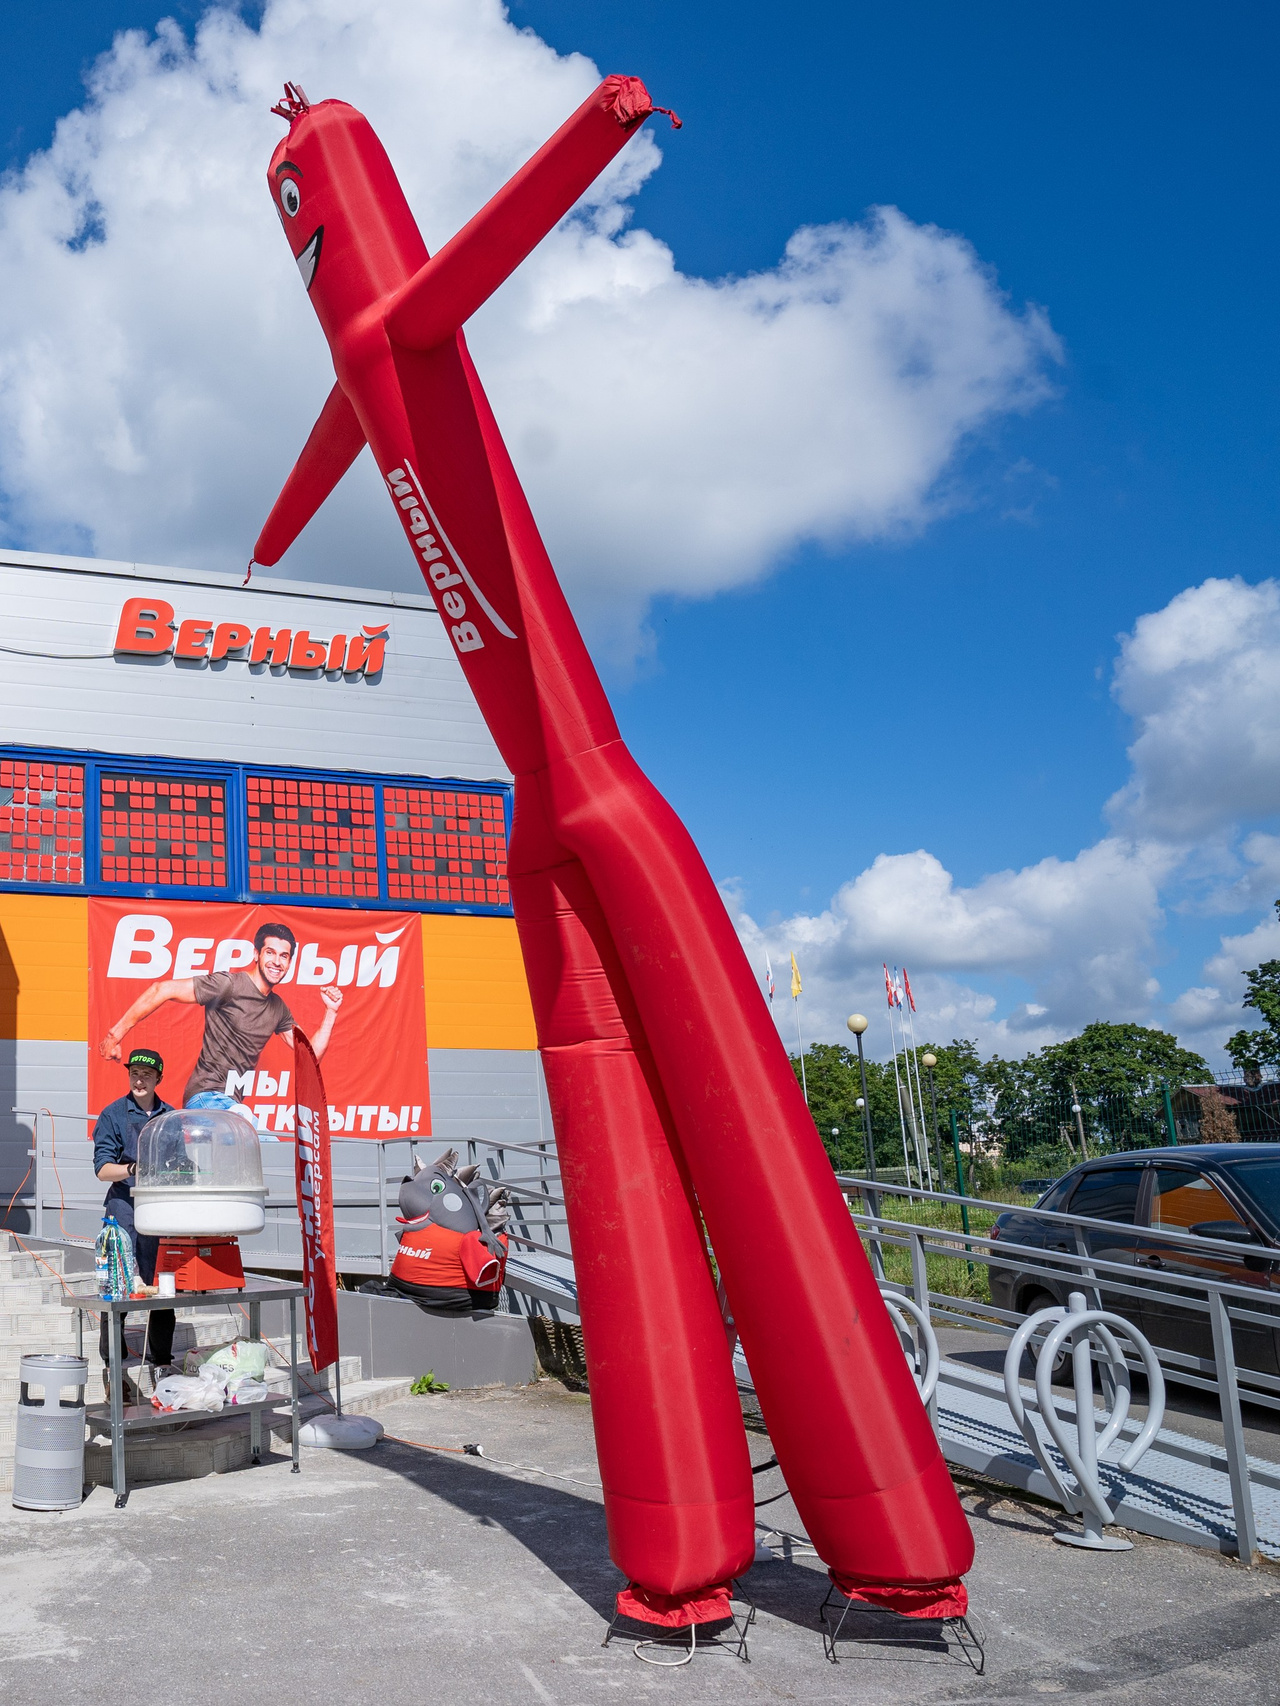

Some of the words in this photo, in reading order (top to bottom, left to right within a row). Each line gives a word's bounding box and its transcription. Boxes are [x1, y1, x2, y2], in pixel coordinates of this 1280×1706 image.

[384, 467, 485, 653] Верный
[224, 1069, 291, 1097] МЫ
[228, 1103, 422, 1132] ОТКЫТЫ!
